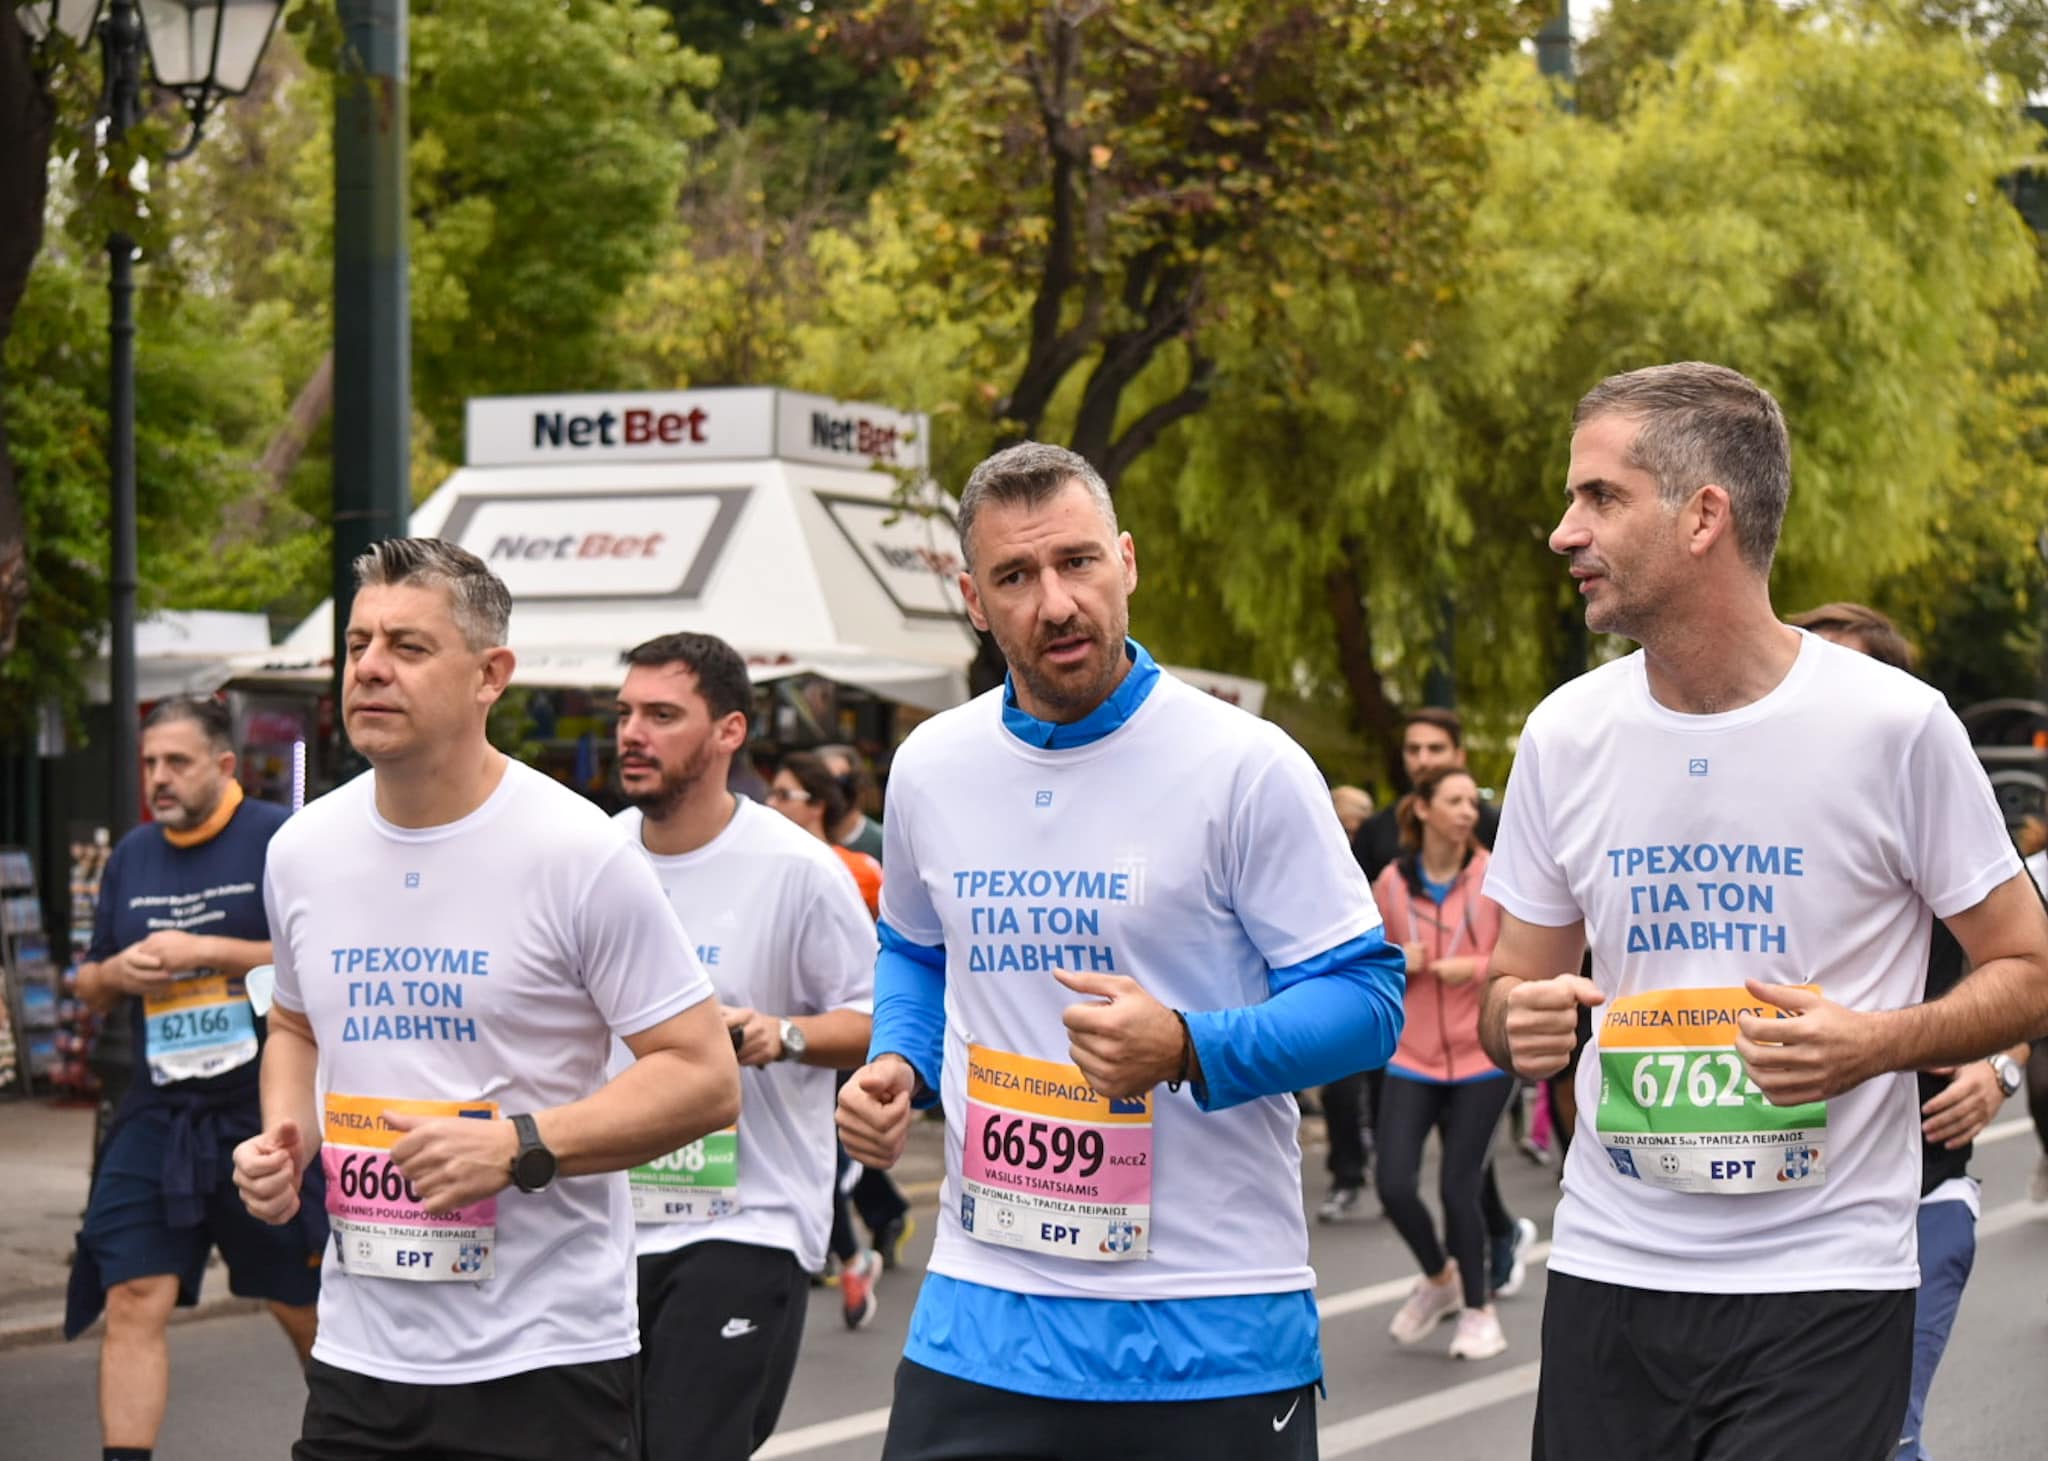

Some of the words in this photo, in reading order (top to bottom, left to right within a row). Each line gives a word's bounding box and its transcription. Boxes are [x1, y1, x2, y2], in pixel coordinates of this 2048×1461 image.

[1607, 843, 1804, 877] ΤΡΕΧΟΥΜΕ
[953, 870, 1129, 900] ΤΡΕΧΟΥΜΕ
[1631, 883, 1690, 914] ΓΙΑ
[1697, 883, 1773, 914] ΤΟΝ
[971, 907, 1020, 935] ΓΙΑ
[1028, 907, 1099, 936] ΤΟΝ
[1627, 921, 1786, 954] ΔΙΑΒΗΤΗ
[331, 947, 489, 976] ΤΡΕΧΟΥΜΕ
[969, 944, 1115, 972] ΔΙΑΒΗΤΗ
[349, 981, 395, 1007] ΓΙΑ
[402, 981, 463, 1008] ΤΟΝ
[161, 1008, 229, 1041] 62166
[342, 1015, 477, 1042] ΔΙΑΒΗΤΗ
[1605, 1010, 1674, 1027] ΤΡΑΠΕΖΑ
[969, 1062, 1020, 1090] ΤΡΑΠΕΖΑ
[1024, 1077, 1098, 1103] ΠΕΙΡΑΙΩΣ
[326, 1111, 373, 1129] ΤΡΑΠΕΖΑ
[983, 1114, 1104, 1178] 66599
[1612, 1135, 1635, 1145] 2021
[1699, 1135, 1750, 1145] ΤΡΑΠΕΖΑ
[985, 1168, 1022, 1187] VASILIS
[1026, 1177, 1099, 1197] TSIATSIAMIS
[1711, 1160, 1756, 1180] ΕΡΤ
[1033, 1198, 1076, 1214] ΤΡΑΠΕΖΑ
[1041, 1222, 1081, 1245] ΕΡΤ
[397, 1250, 434, 1268] ΕΡΤ
